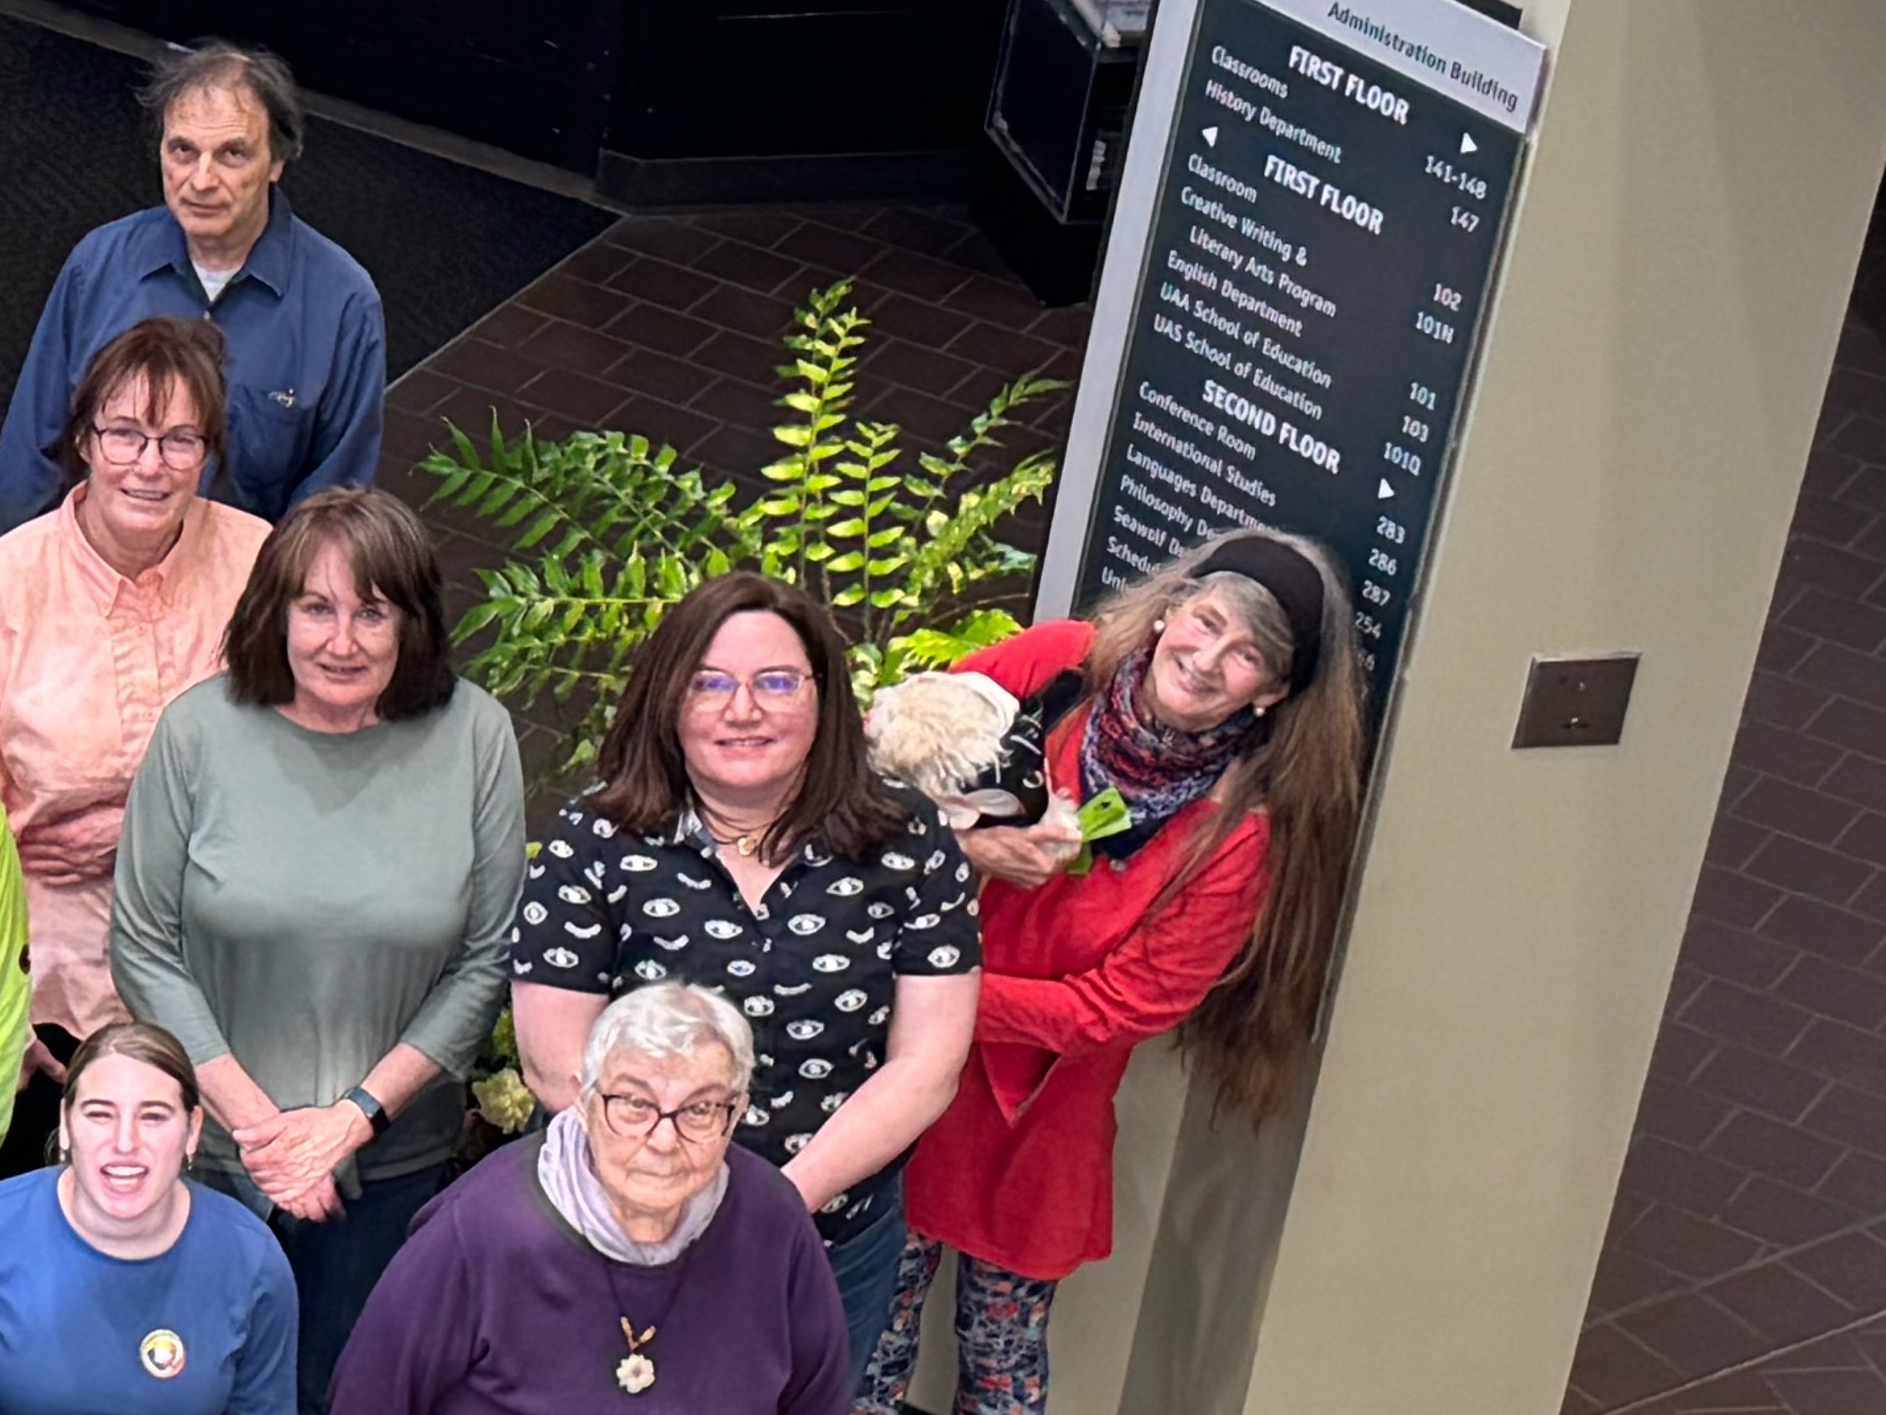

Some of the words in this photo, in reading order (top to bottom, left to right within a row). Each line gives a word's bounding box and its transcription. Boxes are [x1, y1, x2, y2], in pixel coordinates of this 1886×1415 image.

[1211, 45, 1289, 99] Classrooms
[1288, 44, 1345, 92] FIRST
[1344, 73, 1410, 126] FLOOR
[1327, 0, 1448, 75] Administration
[1449, 60, 1519, 113] Building
[1205, 79, 1257, 122] History
[1259, 106, 1343, 164] Department
[1188, 153, 1258, 204] Classroom
[1263, 154, 1321, 200] FIRST
[1320, 183, 1385, 236] FLOOR
[1425, 155, 1487, 200] 141-148
[1181, 186, 1238, 229] Creative
[1241, 217, 1292, 262] Writing
[1295, 246, 1308, 267] &
[1450, 206, 1480, 233] 147
[1167, 249, 1219, 290] English
[1221, 279, 1304, 338] Department
[1189, 225, 1244, 270] Literary
[1244, 256, 1274, 285] Arts
[1278, 273, 1337, 318] Program
[1433, 283, 1463, 312] 102
[1160, 281, 1190, 312] UAA
[1193, 299, 1241, 340] School
[1243, 330, 1260, 348] of
[1262, 337, 1333, 390] Education
[1153, 313, 1183, 343] UAS
[1184, 330, 1232, 371] School
[1234, 361, 1252, 379] of
[1253, 368, 1324, 421] Education
[1409, 382, 1437, 410] 101
[1139, 381, 1215, 436] Conference
[1217, 425, 1257, 461] Room
[1202, 379, 1277, 436] SECOND
[1278, 421, 1342, 475] FLOOR
[1401, 415, 1430, 443] 103
[1126, 443, 1197, 498] Languages
[1200, 486, 1270, 532] Departme
[1132, 411, 1224, 478] International
[1226, 465, 1277, 507] Studies
[1383, 441, 1422, 477] 101Q
[1114, 505, 1167, 547] Seawolf
[1120, 474, 1194, 532] Philosophy
[1377, 515, 1406, 545] 283
[1368, 548, 1398, 576] 286
[1361, 580, 1391, 607] 287
[1355, 611, 1382, 639] 254
